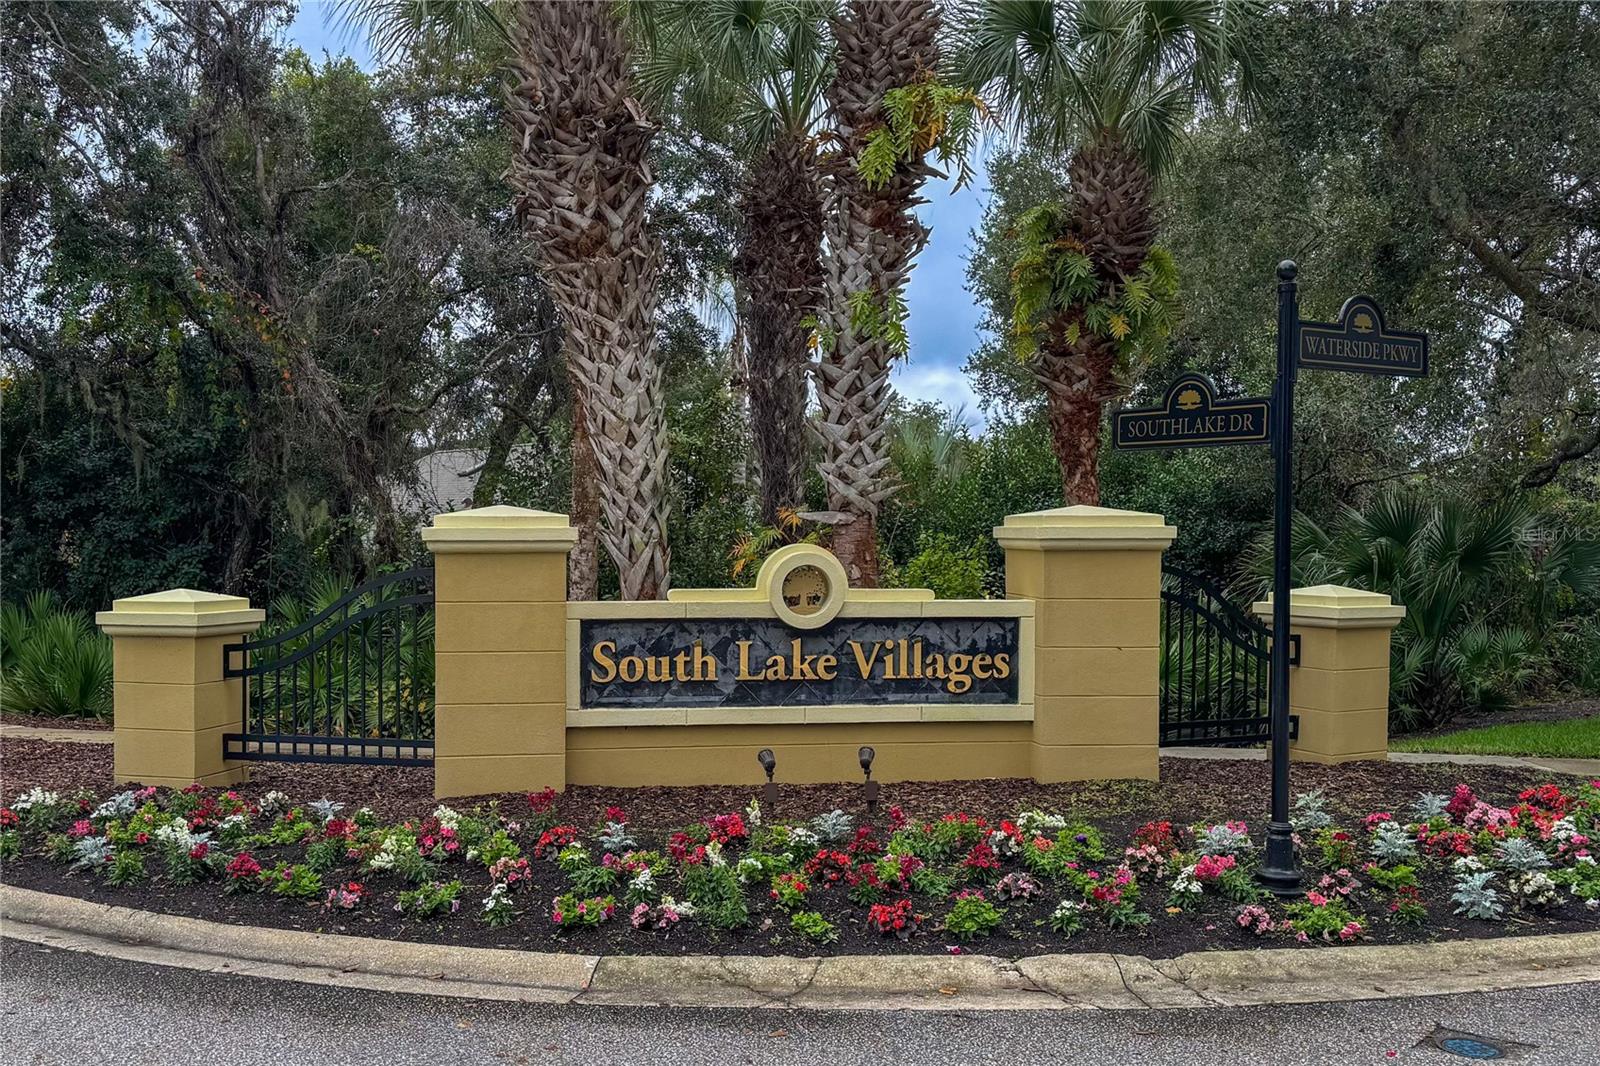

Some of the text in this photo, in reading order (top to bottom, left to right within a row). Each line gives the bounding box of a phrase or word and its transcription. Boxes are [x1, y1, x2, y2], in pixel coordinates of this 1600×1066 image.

[1306, 336, 1417, 363] WATERSIDE PKWY
[1128, 414, 1254, 438] SOUTHLAKE DR
[591, 638, 1011, 694] South Lake Villages
